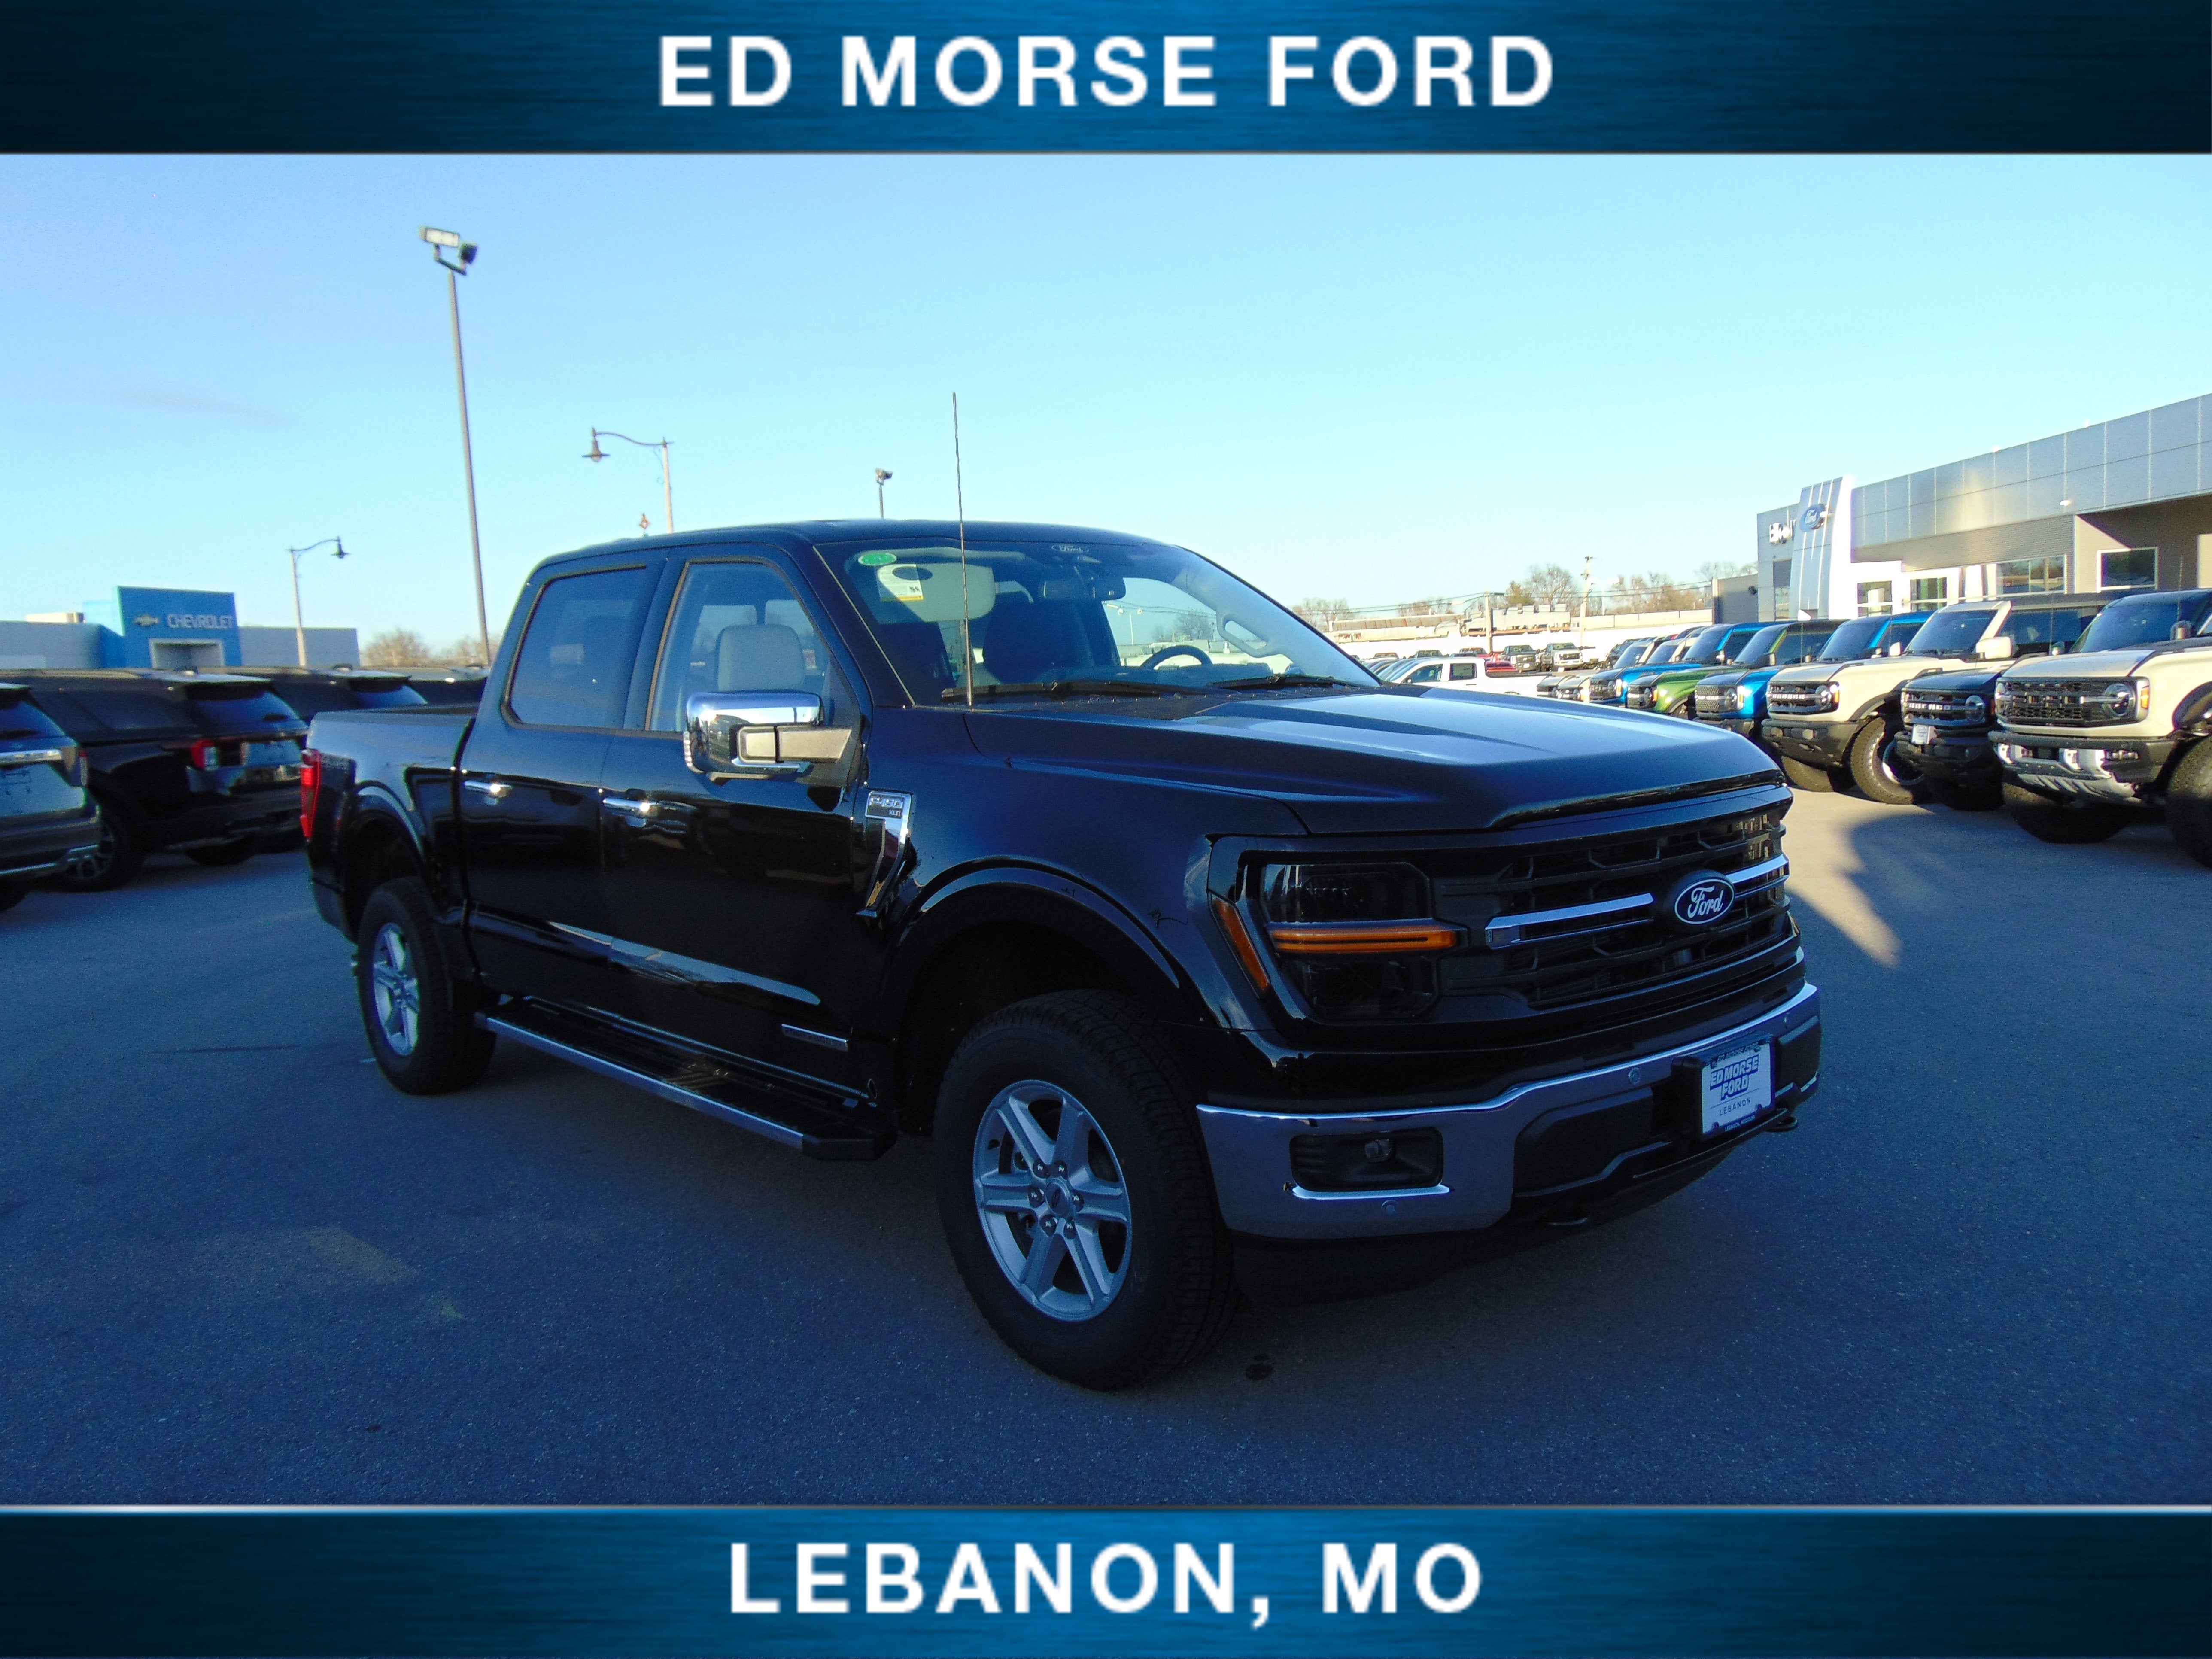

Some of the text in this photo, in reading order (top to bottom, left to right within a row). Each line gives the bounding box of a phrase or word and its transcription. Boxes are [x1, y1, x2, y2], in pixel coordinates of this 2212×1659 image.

[167, 614, 233, 628] CHEVROLET
[1687, 885, 1724, 918] Ford
[1710, 1054, 1759, 1091] ED MORSE
[1720, 1074, 1749, 1101] FORD
[1719, 1097, 1751, 1116] LEBANON
